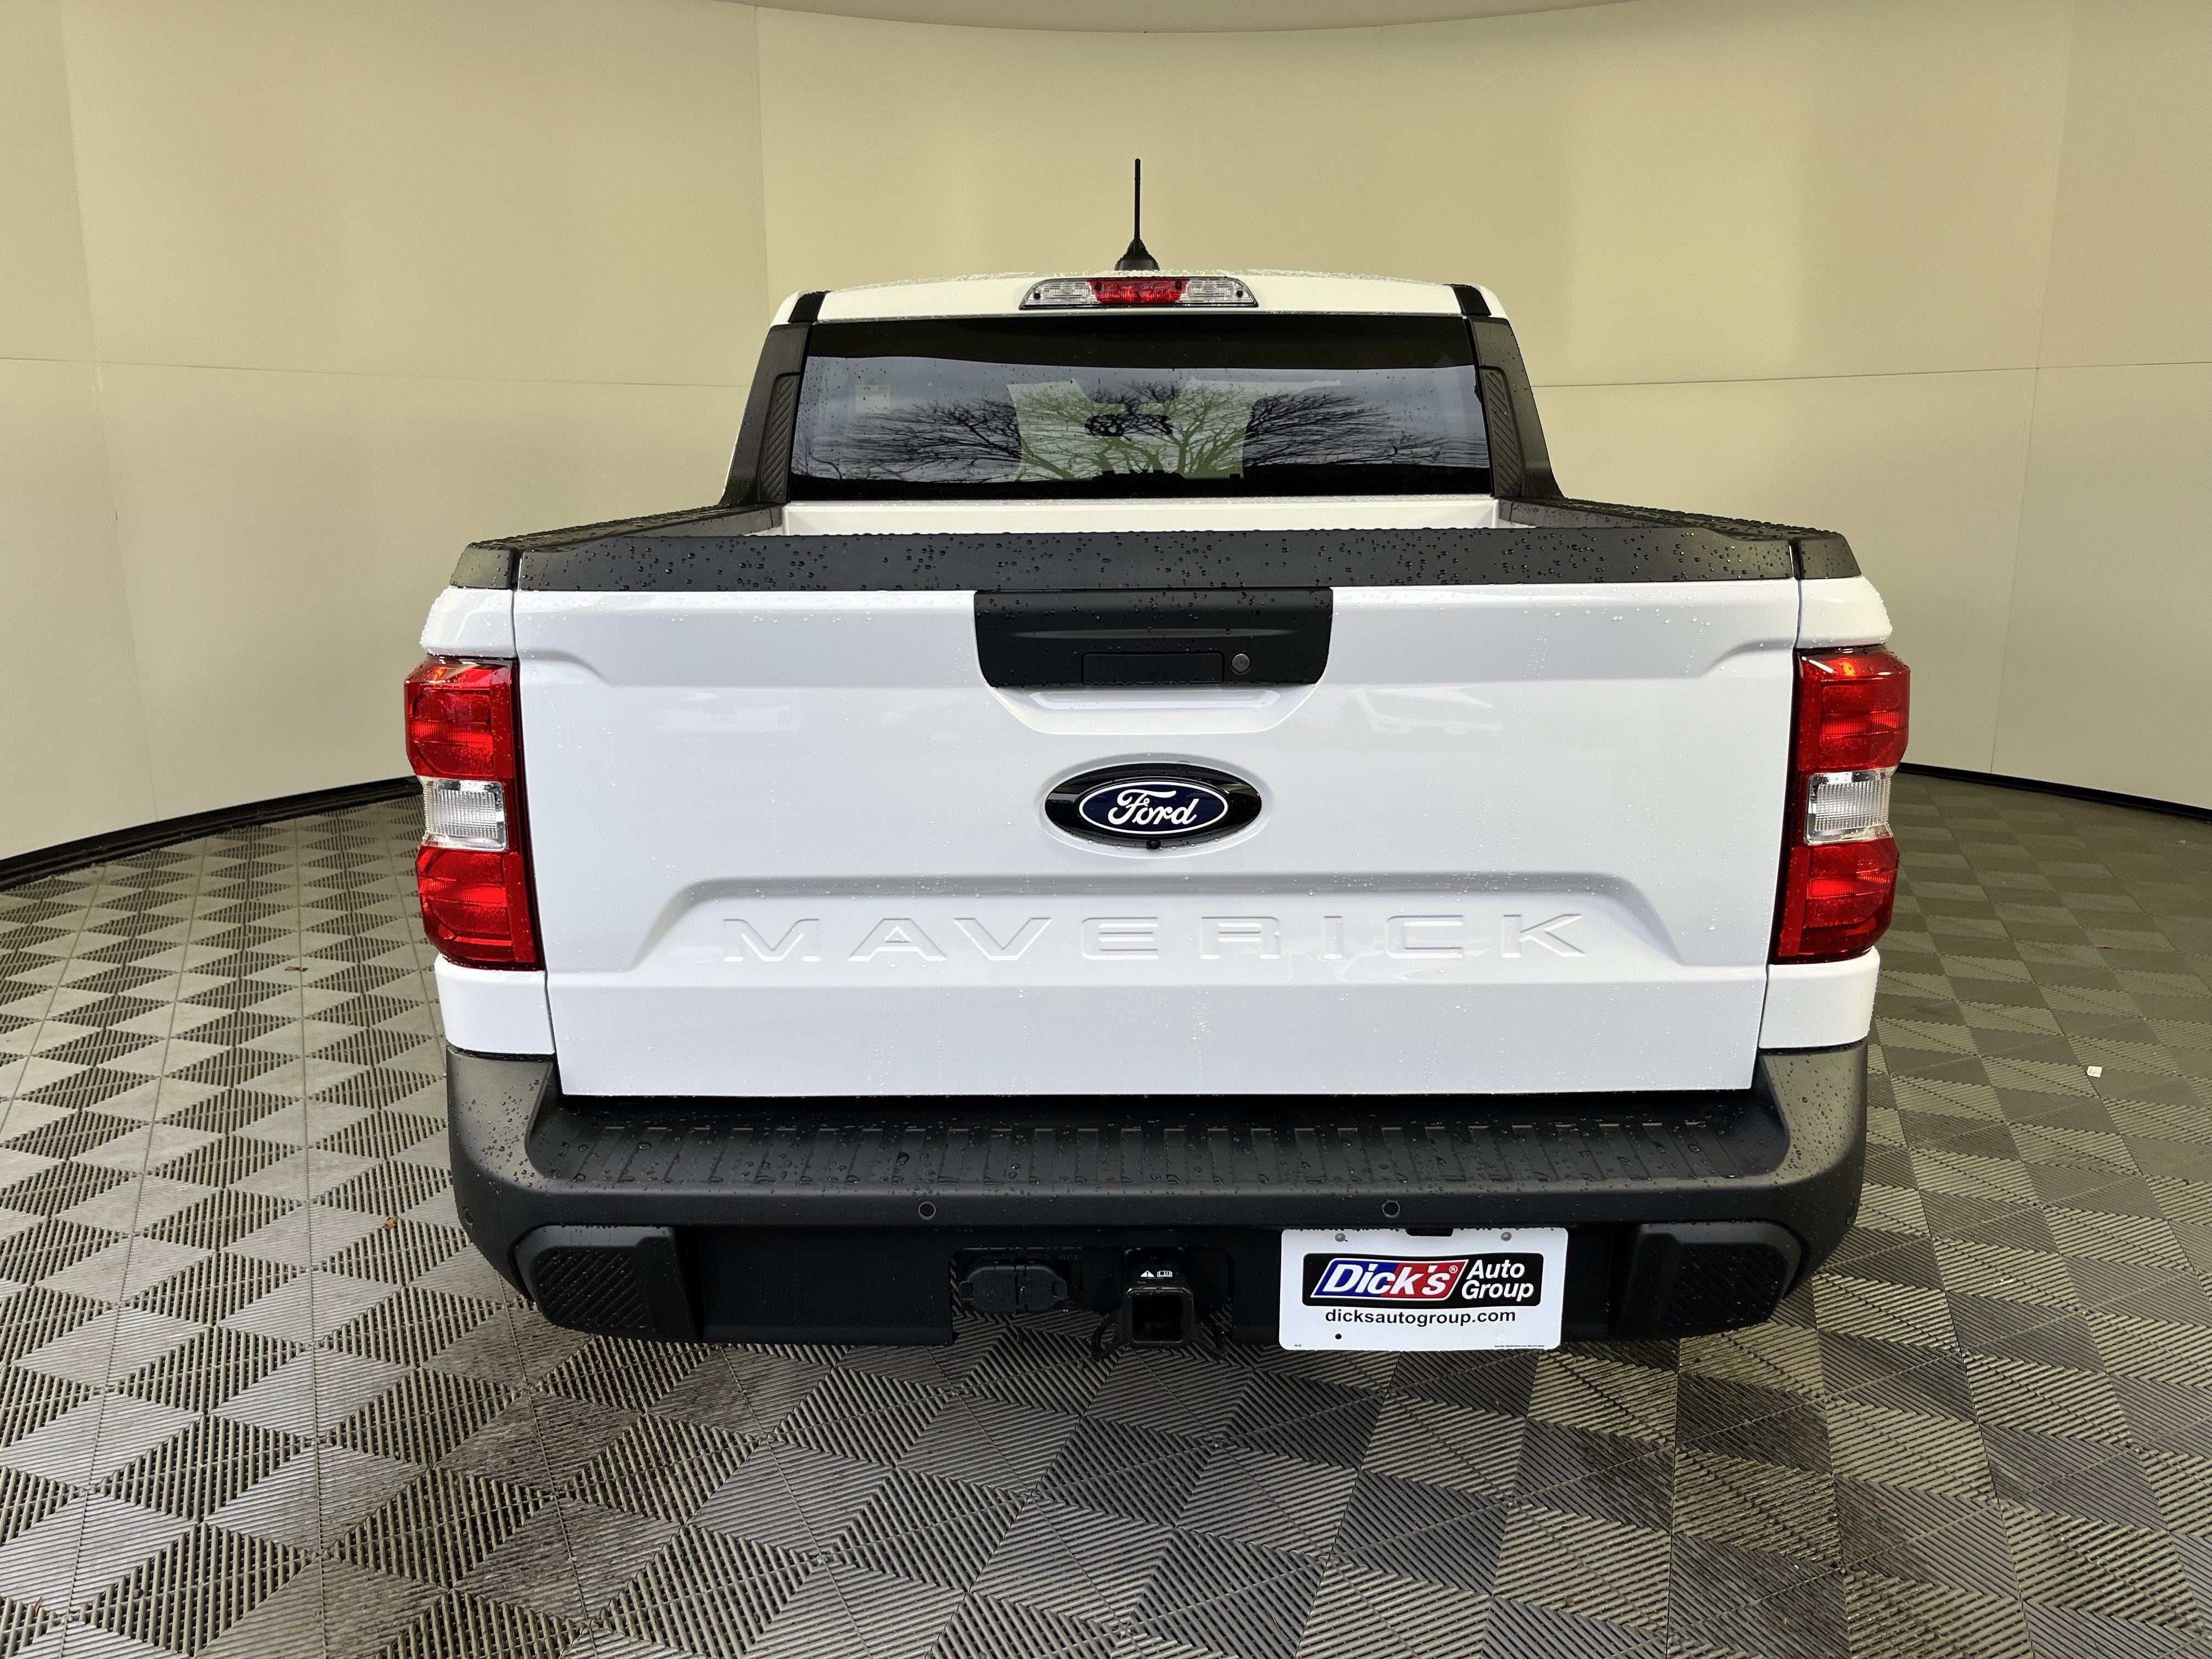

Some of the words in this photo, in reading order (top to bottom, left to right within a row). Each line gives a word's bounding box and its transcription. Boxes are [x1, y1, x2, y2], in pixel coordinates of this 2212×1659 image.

[1107, 788, 1199, 825] Ford
[723, 914, 1587, 962] MAVERICK
[1466, 1260, 1525, 1280] Auto
[1462, 1279, 1534, 1302] Group
[1325, 1309, 1516, 1327] dicksautogroup.com
